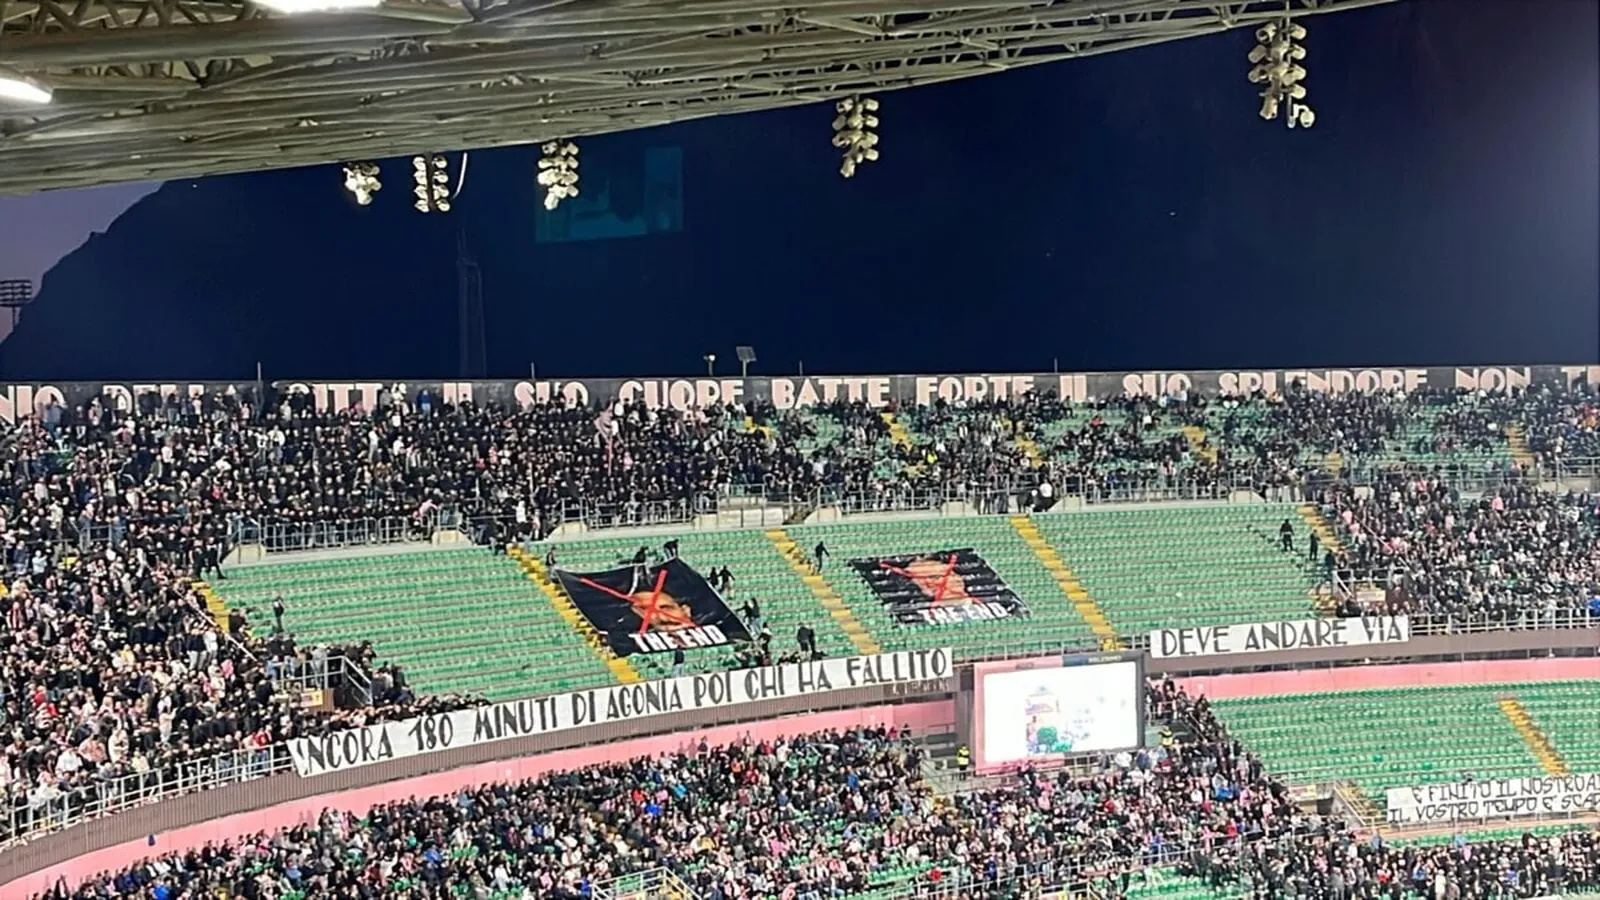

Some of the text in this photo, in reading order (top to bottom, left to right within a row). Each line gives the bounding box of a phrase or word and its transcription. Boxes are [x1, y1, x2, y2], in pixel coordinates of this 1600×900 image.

[619, 380, 744, 412] CUORE
[771, 377, 890, 409] BATTE
[915, 376, 1034, 408] FORTE
[1455, 367, 1531, 398] NON
[917, 606, 964, 625] THE
[628, 624, 728, 652] THE END
[1161, 615, 1402, 656] DEVE ANDARE VIA
[407, 714, 453, 751] 180
[473, 695, 557, 742] MINUTI
[571, 690, 596, 724] DI
[606, 680, 683, 720] AGONIA
[693, 670, 732, 707] POI
[745, 665, 785, 701] CHI
[799, 660, 832, 693] HA
[846, 648, 947, 686] FALLITO
[1428, 780, 1491, 802] FINITO
[1496, 779, 1517, 798] IL
[1520, 774, 1585, 796] NOSTRO
[1389, 808, 1411, 823] IL
[1416, 801, 1479, 822] VOSTRO
